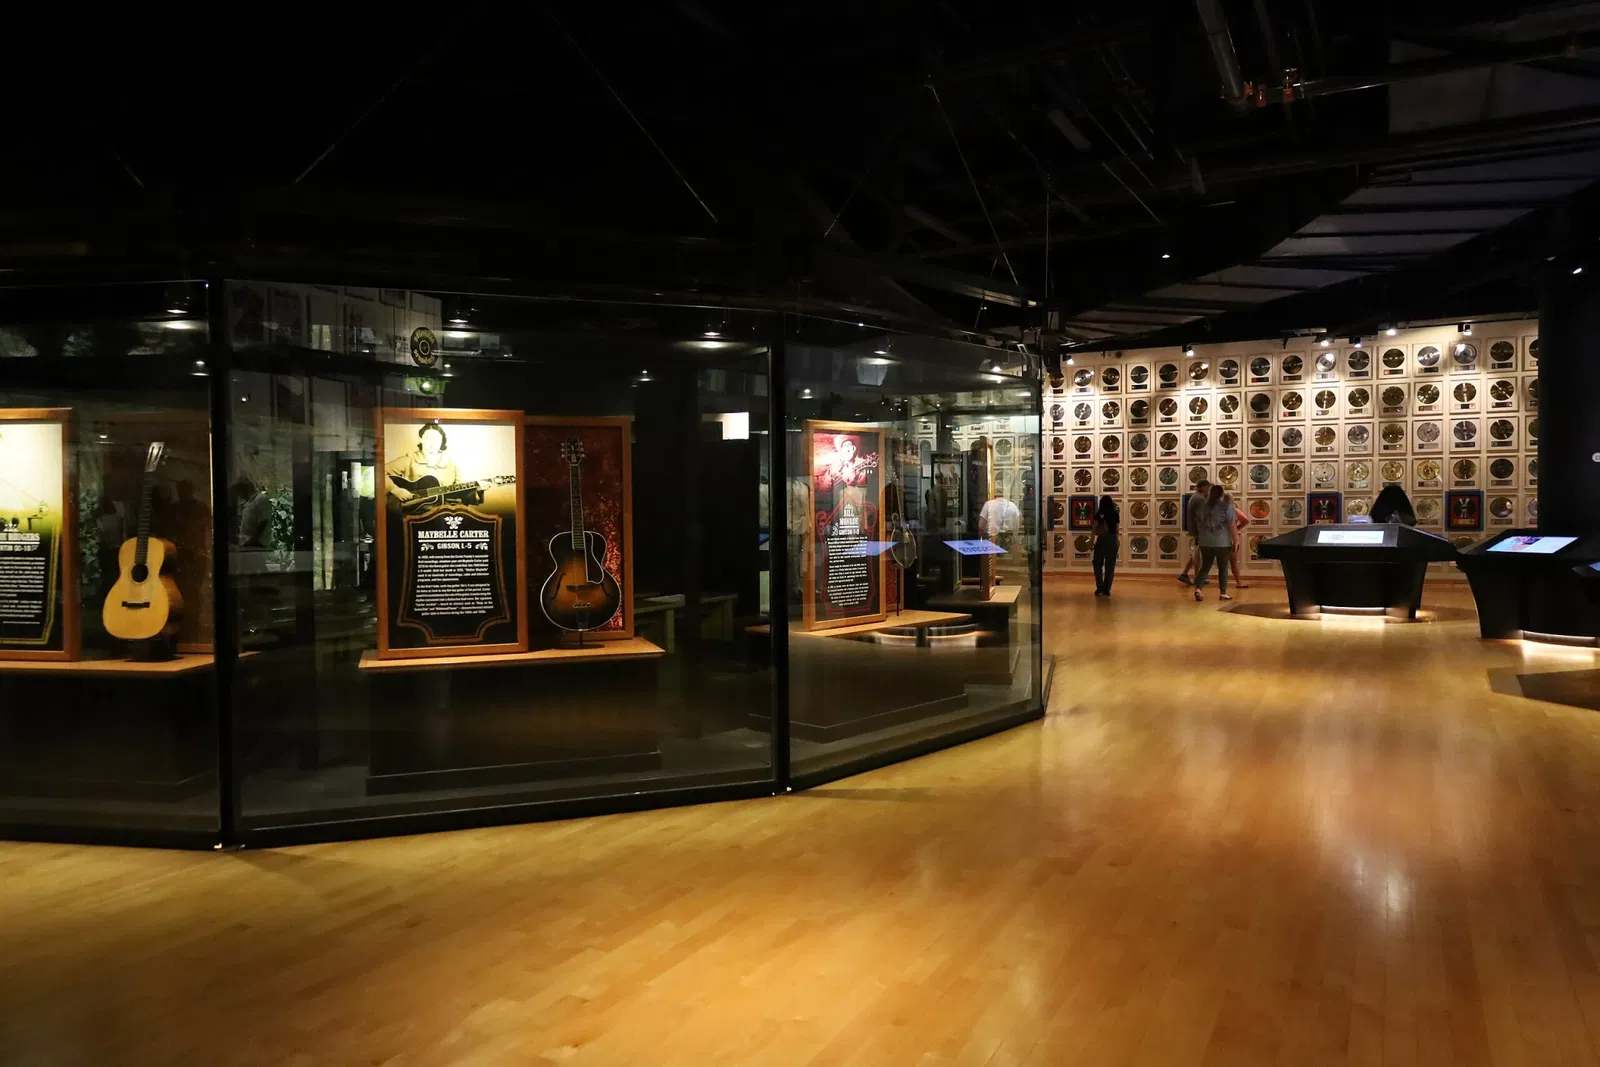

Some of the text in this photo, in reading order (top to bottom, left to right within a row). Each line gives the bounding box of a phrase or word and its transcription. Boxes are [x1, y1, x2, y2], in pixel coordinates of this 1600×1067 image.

[417, 530, 490, 539] MAYBELLE CARTER
[437, 542, 460, 550] GIBSON
